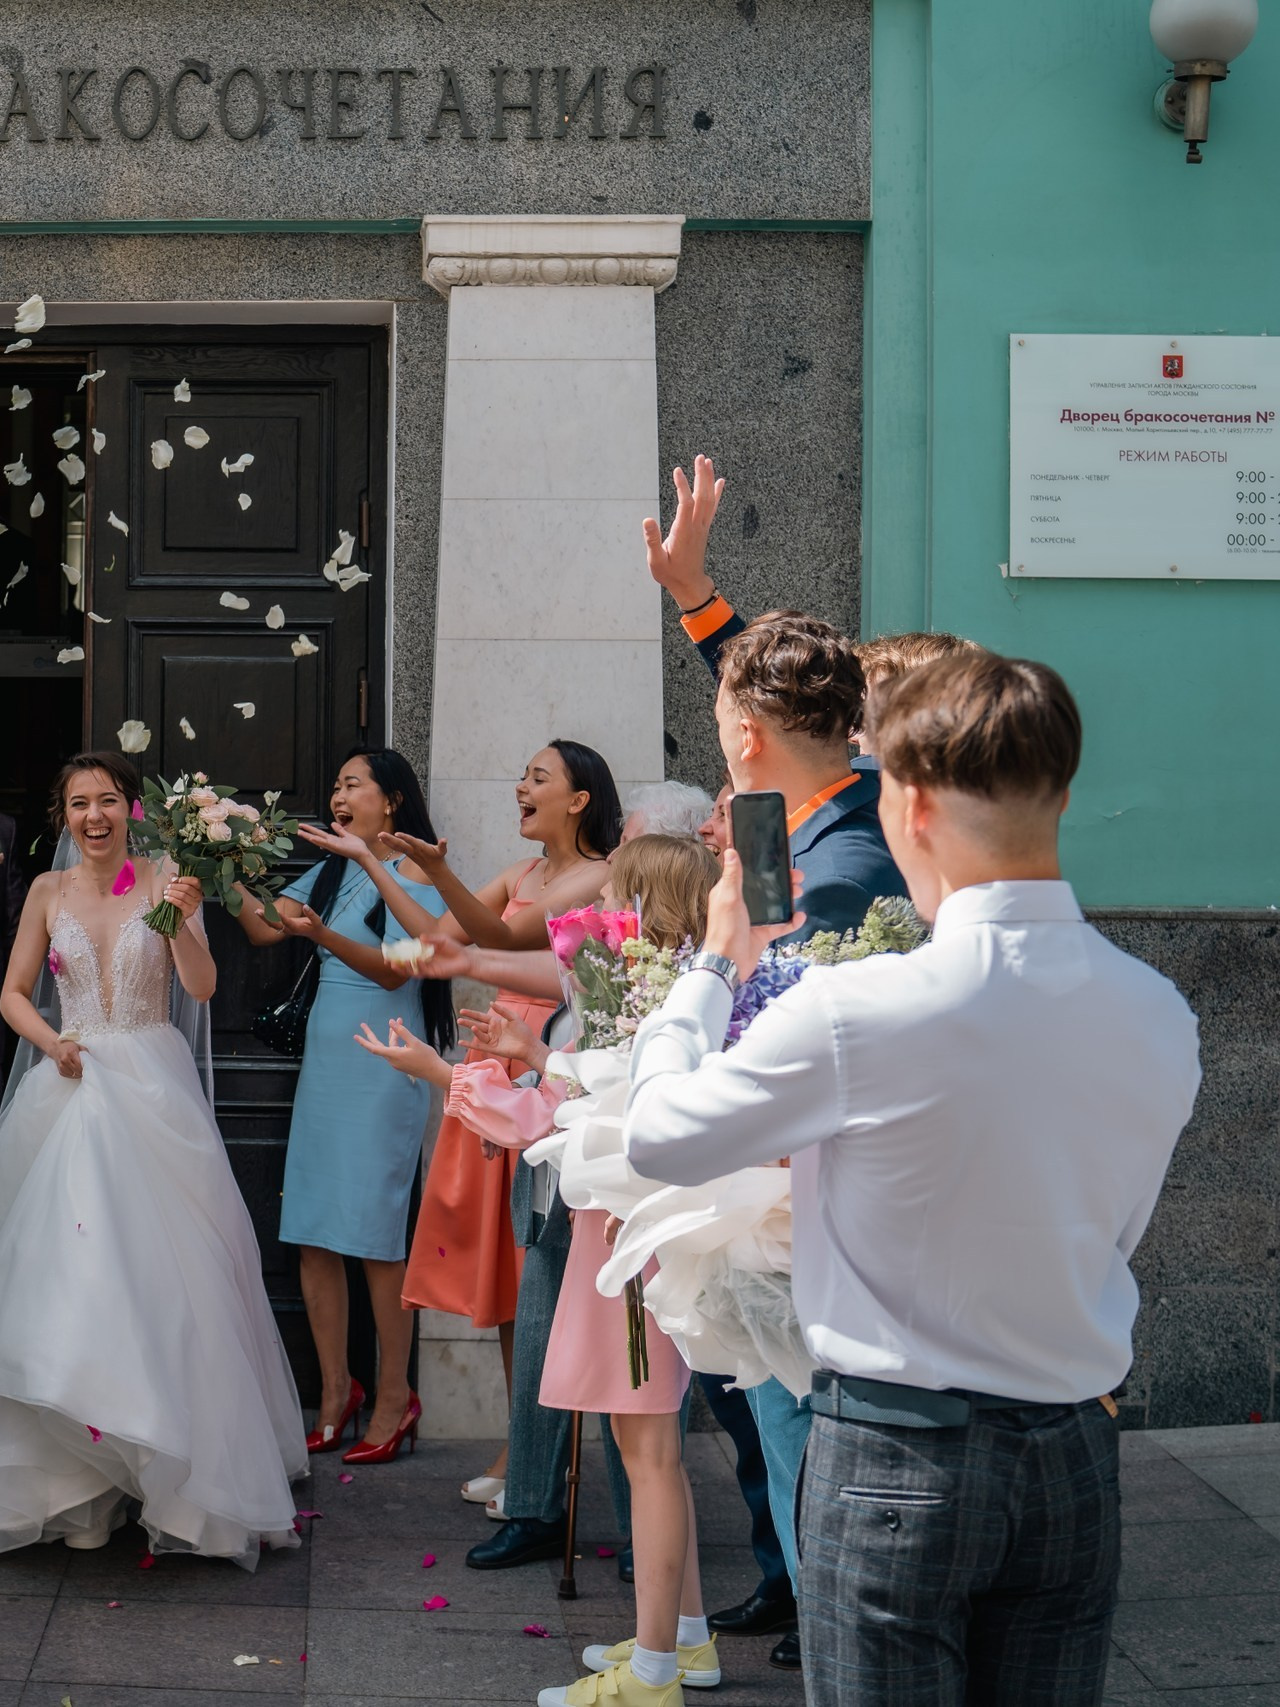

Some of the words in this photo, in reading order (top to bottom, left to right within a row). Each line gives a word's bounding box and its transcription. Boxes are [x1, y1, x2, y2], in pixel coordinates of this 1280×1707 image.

[1153, 382, 1171, 390] АКТОВ
[1060, 409, 1120, 425] Дворец
[1124, 408, 1252, 426] бракосочетания
[1256, 411, 1275, 423] №
[1119, 450, 1170, 462] РЕЖИМ
[1174, 450, 1228, 463] РАБОТЫ
[1236, 470, 1266, 483] 9:00
[1030, 494, 1062, 502] ПЯТНИЦА
[1236, 491, 1266, 504] 9:00
[1030, 515, 1060, 523] СУББОТА
[1236, 512, 1266, 525] 9:00
[1030, 536, 1076, 544] ВОСКРЕСЕНЬЕ
[1227, 533, 1266, 546] 00:00
